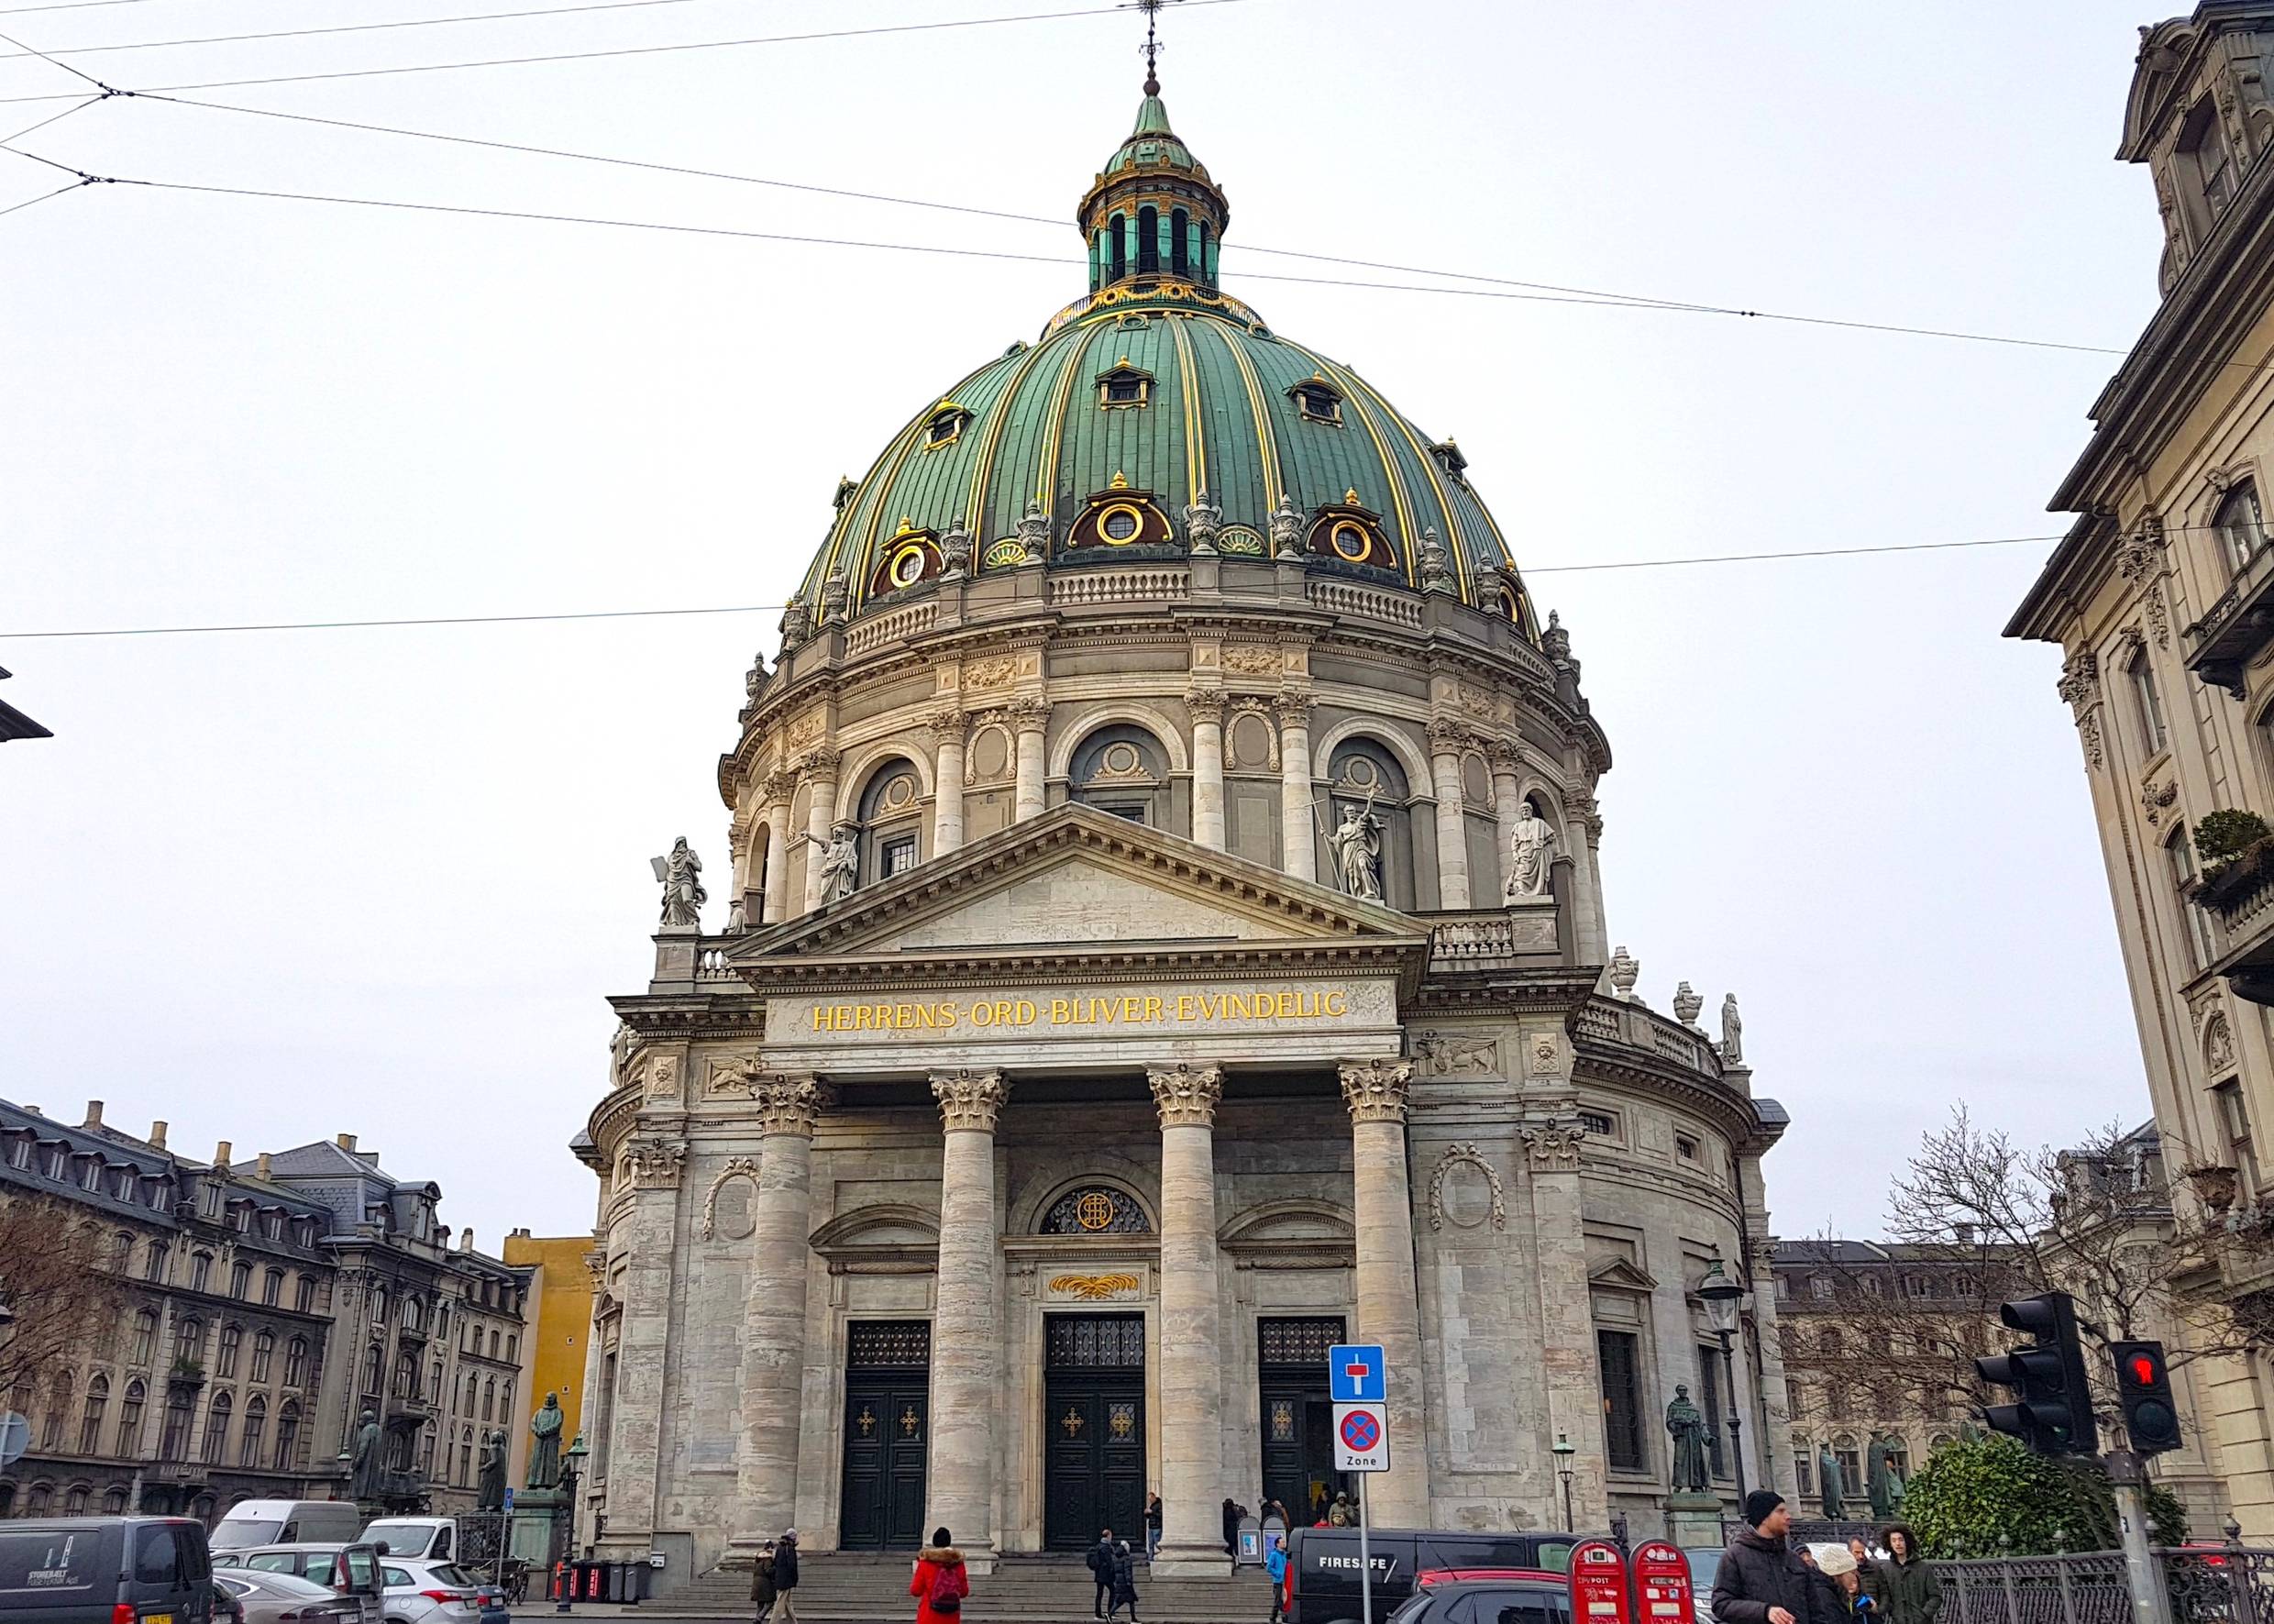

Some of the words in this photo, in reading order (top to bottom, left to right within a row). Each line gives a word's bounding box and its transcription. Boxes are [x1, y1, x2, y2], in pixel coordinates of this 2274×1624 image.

[812, 1002, 957, 1031] HERRENS
[970, 1000, 1036, 1026] ORD
[1051, 996, 1165, 1024] BLIVER
[1176, 991, 1348, 1022] EVINDELIG
[1346, 1456, 1377, 1466] Zone
[1319, 1556, 1387, 1570] FIRESFE
